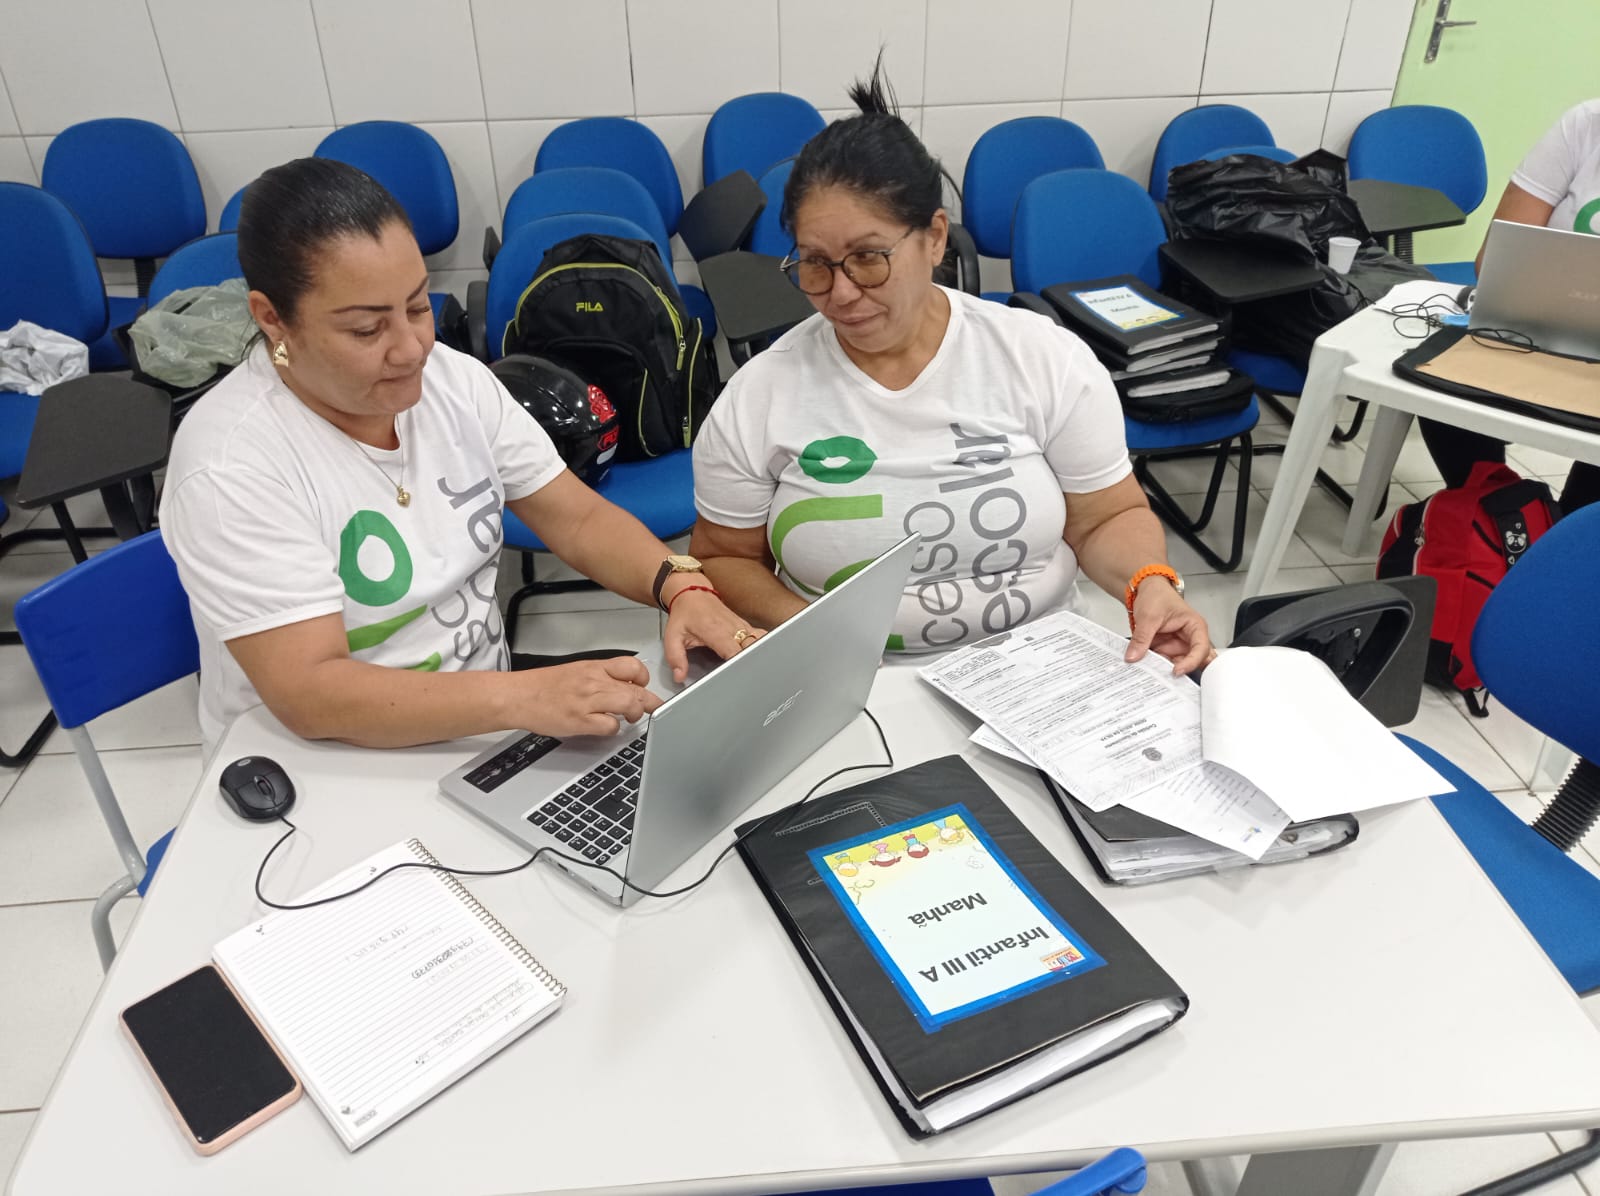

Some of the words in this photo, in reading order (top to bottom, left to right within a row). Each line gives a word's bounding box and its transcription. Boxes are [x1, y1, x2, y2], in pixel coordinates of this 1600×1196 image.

[576, 302, 603, 312] FILA
[907, 892, 988, 929] Manhã
[965, 926, 1051, 967] Infantil
[918, 966, 940, 983] A
[941, 957, 968, 976] III
